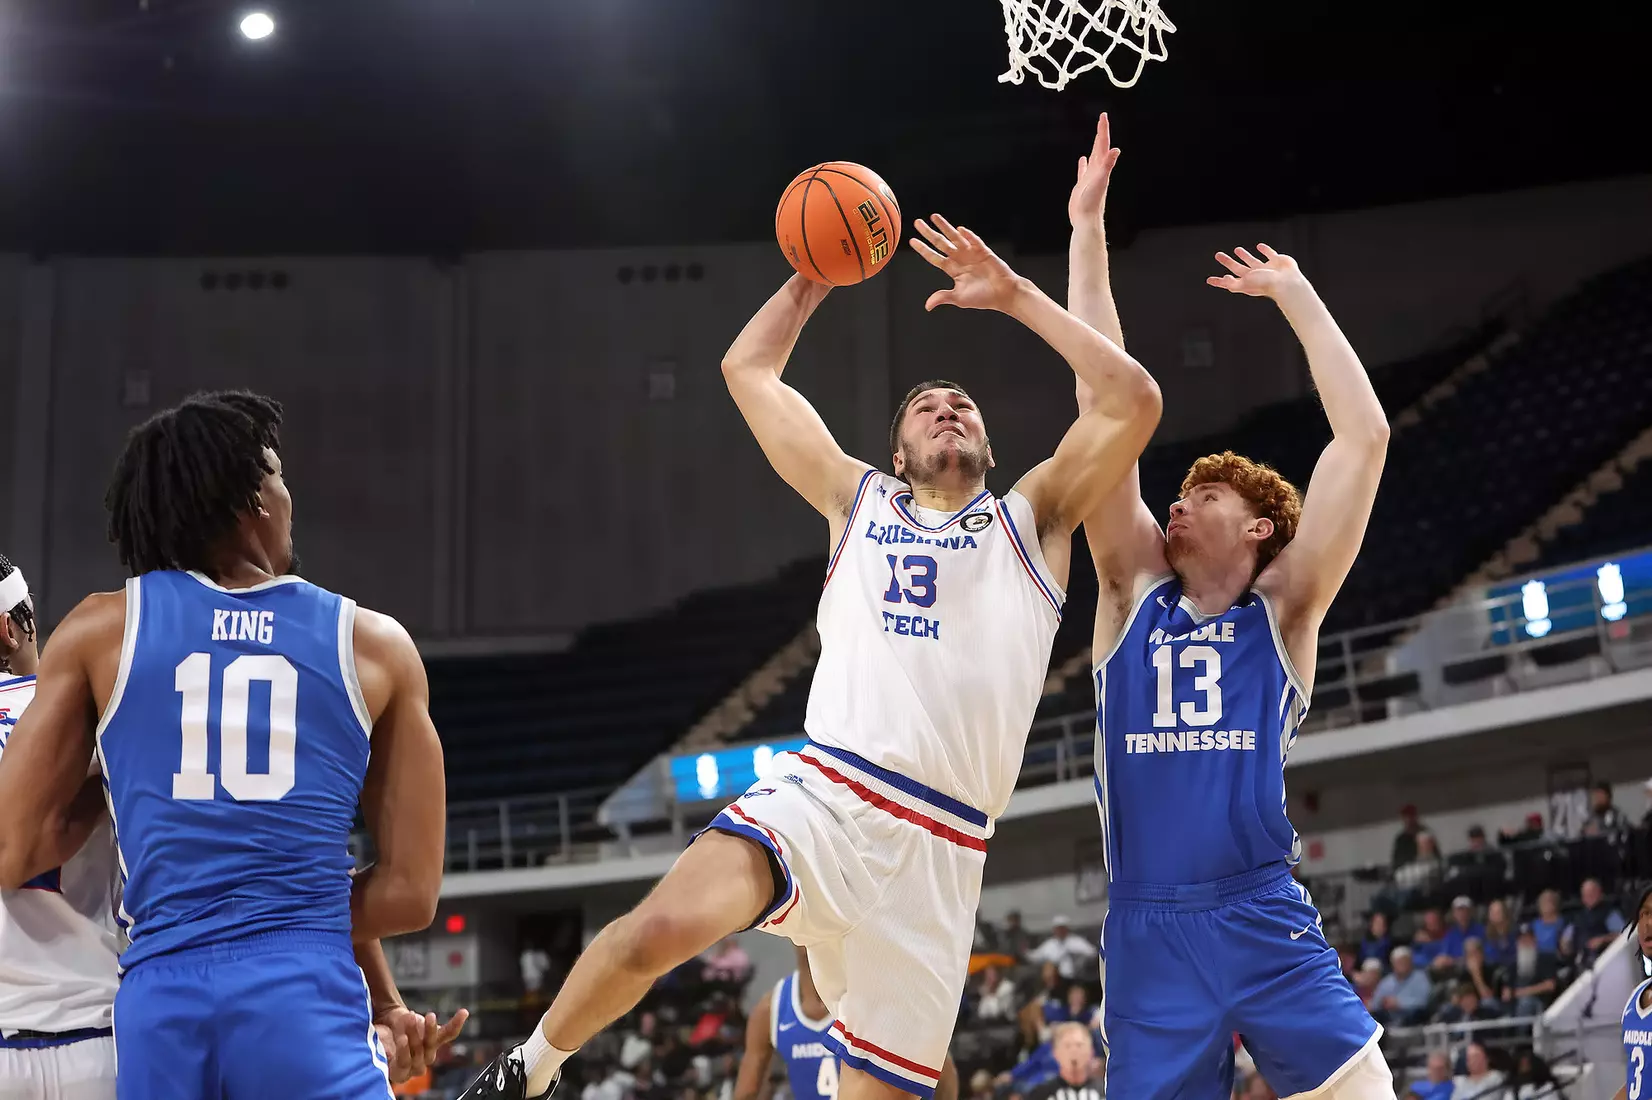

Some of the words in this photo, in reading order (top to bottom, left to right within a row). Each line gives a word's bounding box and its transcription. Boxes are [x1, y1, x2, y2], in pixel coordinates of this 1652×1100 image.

[857, 199, 889, 264] ELITE
[883, 553, 938, 608] 13
[211, 609, 274, 644] KING
[882, 611, 940, 640] TECH
[1149, 622, 1235, 645] MDLE
[1152, 645, 1223, 728] 13
[172, 652, 299, 801] 10
[1125, 730, 1256, 754] TENNESSEE
[816, 1057, 839, 1100] 4
[1629, 1046, 1645, 1100] 3
